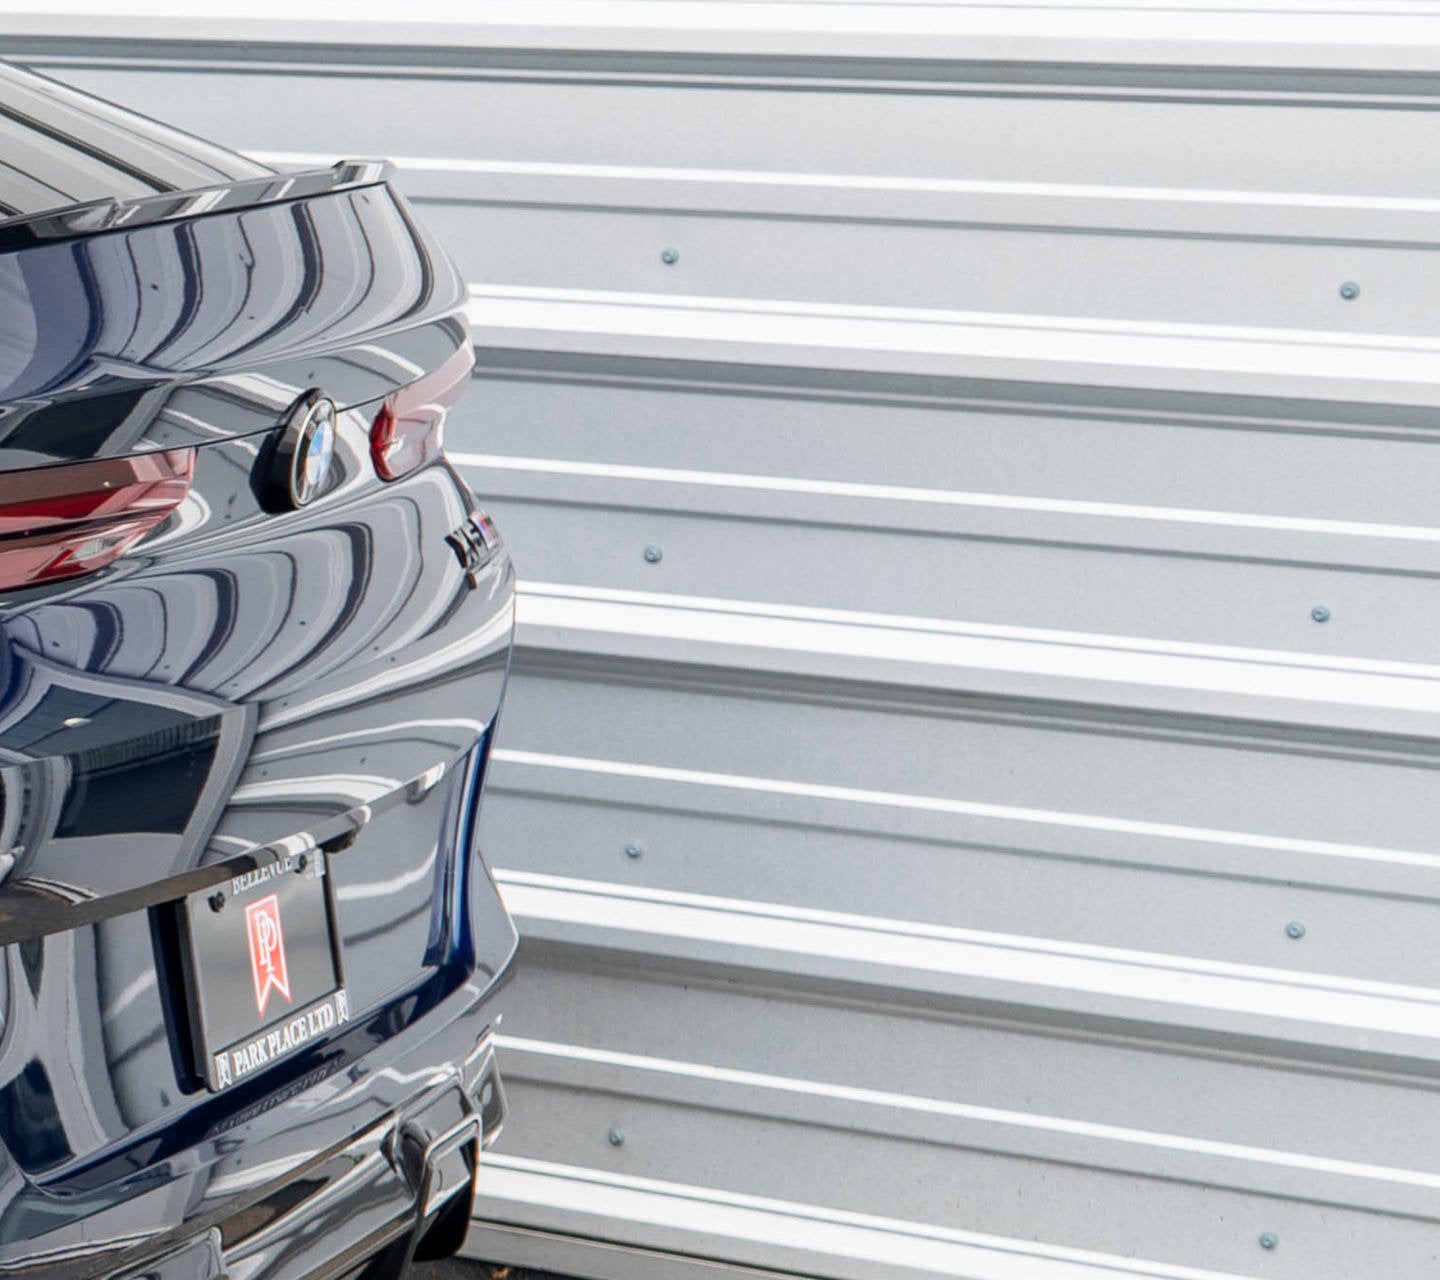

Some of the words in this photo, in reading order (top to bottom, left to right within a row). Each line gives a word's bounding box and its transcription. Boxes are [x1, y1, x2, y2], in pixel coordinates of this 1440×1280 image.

[232, 857, 292, 895] BELLEVUE
[232, 1037, 270, 1077] PARK
[267, 1015, 309, 1058] PLACE
[307, 1003, 334, 1036] LTD
